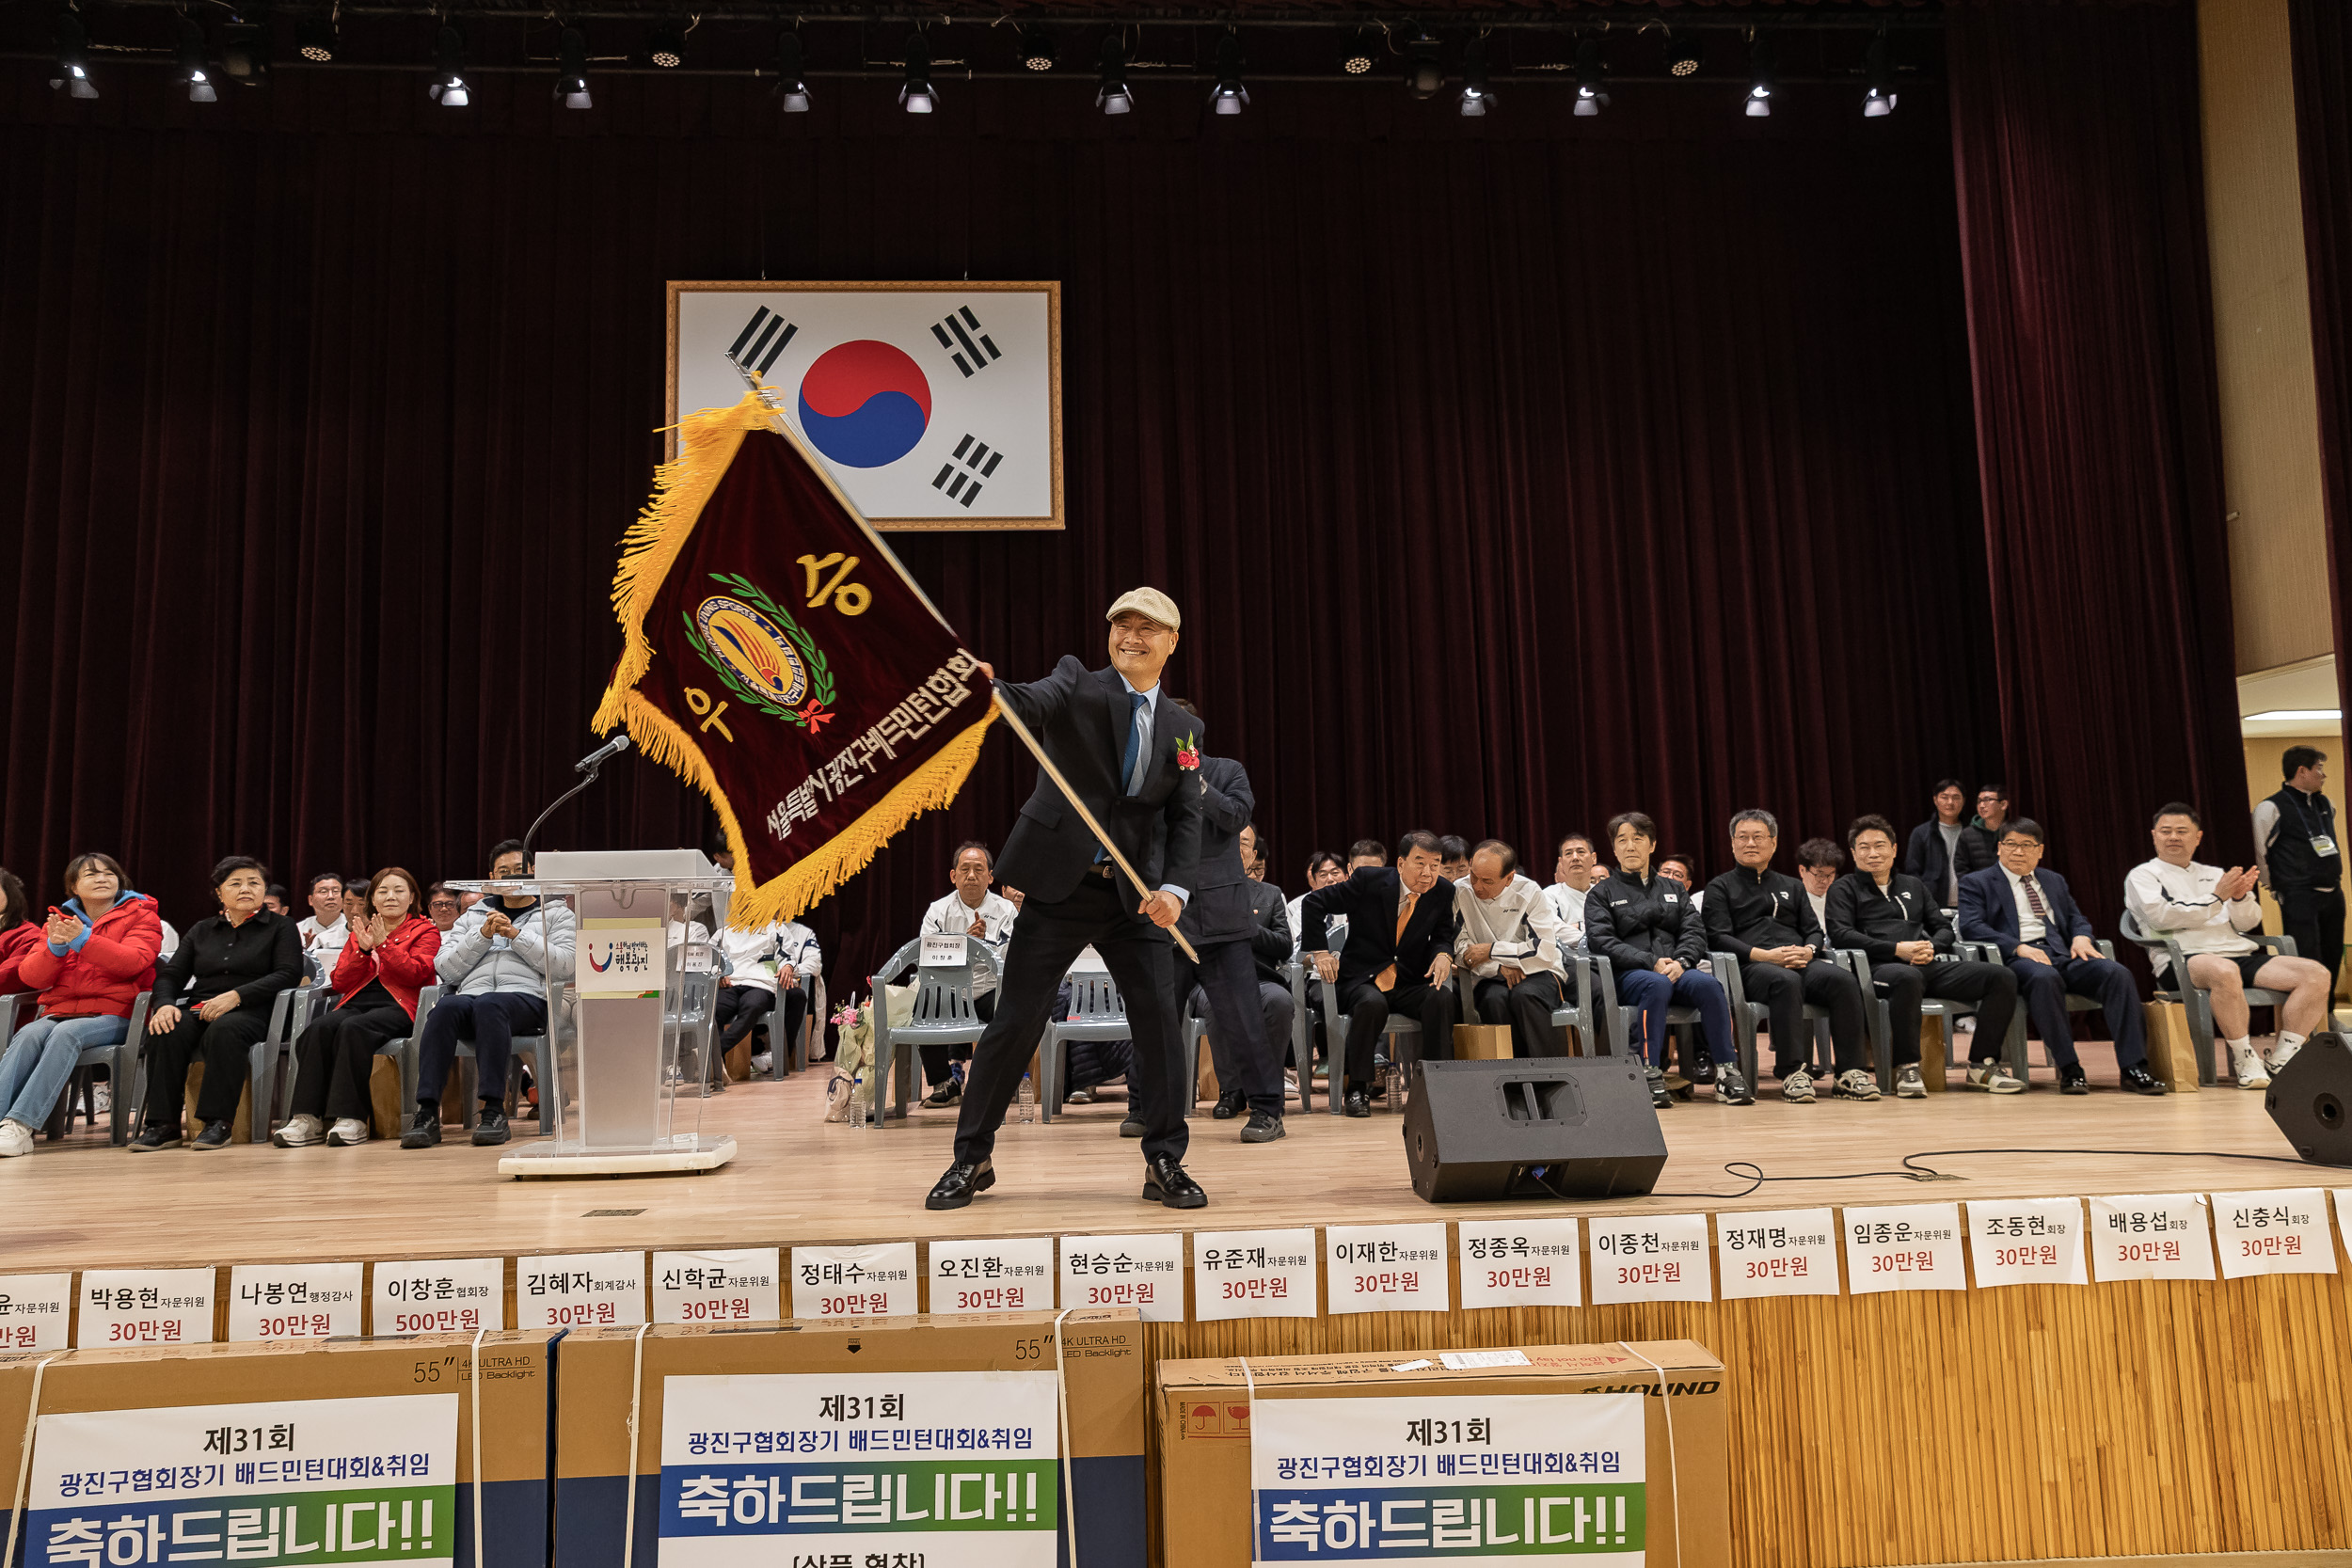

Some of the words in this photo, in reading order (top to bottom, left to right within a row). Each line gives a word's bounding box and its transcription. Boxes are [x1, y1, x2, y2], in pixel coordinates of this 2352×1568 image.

[796, 552, 873, 616] 승
[615, 952, 648, 973] 행복광진
[1995, 1245, 2058, 1266] 30만원
[2119, 1241, 2180, 1261] 30만원
[2242, 1235, 2301, 1257] 30만원
[1747, 1257, 1808, 1279] 30만원
[1872, 1250, 1933, 1273] 30만원
[1357, 1271, 1419, 1293] 30만원
[1487, 1266, 1550, 1289] 30만원
[1619, 1262, 1680, 1284] 30만원
[959, 1287, 1024, 1309] 30만원
[1089, 1283, 1153, 1305] 30만원
[1223, 1277, 1288, 1300] 30만원
[548, 1303, 614, 1325] 30만원
[683, 1298, 749, 1320] 30만원
[821, 1292, 887, 1315] 30만원
[110, 1320, 182, 1341] 30만원
[260, 1314, 330, 1337] 30만원
[396, 1308, 479, 1332] 500만원
[1076, 1336, 1110, 1346] ULTRA
[1111, 1335, 1126, 1344] HD
[478, 1357, 513, 1368] ULTRA
[515, 1355, 531, 1366] HD
[1085, 1348, 1132, 1358] Backlight
[486, 1370, 536, 1380] Backlight
[818, 1393, 904, 1422] 제31회
[202, 1422, 296, 1457] 제31회
[688, 1430, 839, 1455] 광진구협회장기
[849, 1428, 1032, 1451] 배드민턴대회&취임
[1406, 1418, 1491, 1447] 제31회
[59, 1464, 225, 1498] 광진구협회장기
[235, 1453, 430, 1485] 배드민턴대회&취임
[1278, 1455, 1427, 1480] 광진구협회장기
[1438, 1451, 1620, 1476] 배드민턴대회&취임
[677, 1472, 1038, 1528] 축하드립니다!!
[47, 1498, 434, 1568] 축하드립니다!!
[1269, 1496, 1626, 1553] 축하드립니다!!
